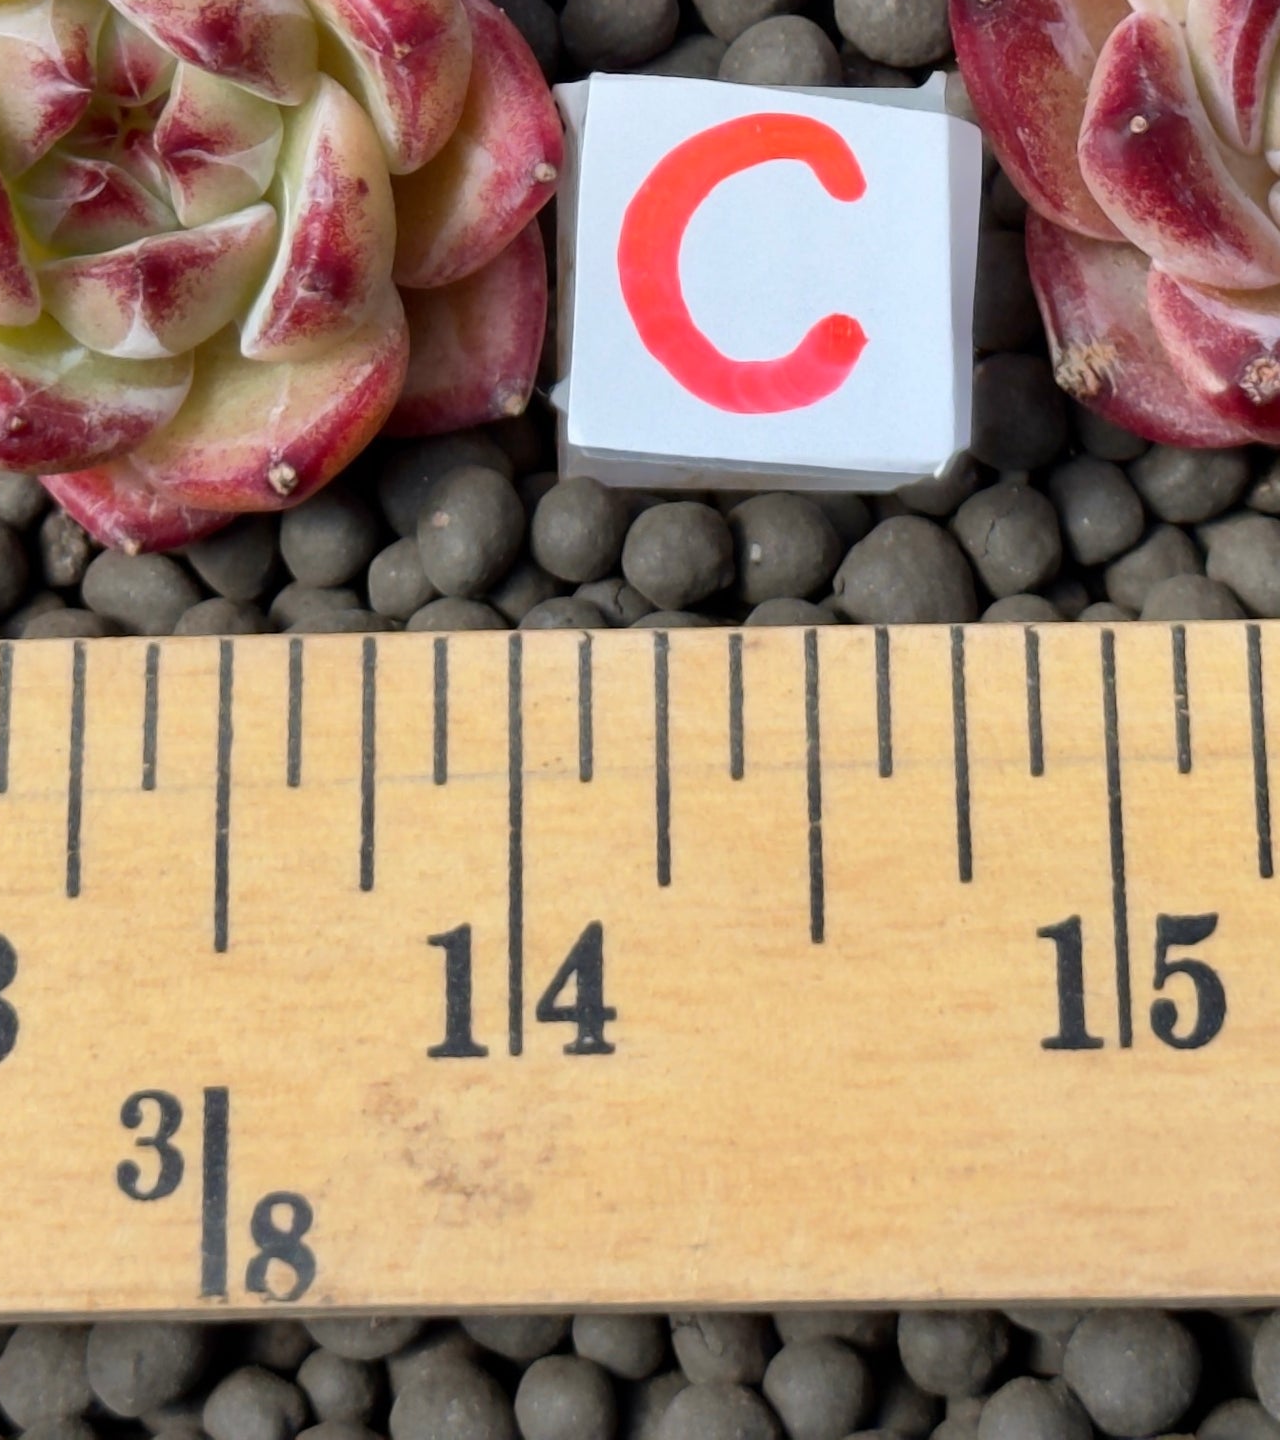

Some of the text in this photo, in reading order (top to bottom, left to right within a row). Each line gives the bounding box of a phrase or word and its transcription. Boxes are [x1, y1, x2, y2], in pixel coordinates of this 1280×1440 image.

[616, 112, 869, 416] C
[425, 922, 619, 1058] 14
[1035, 913, 1229, 1052] 15
